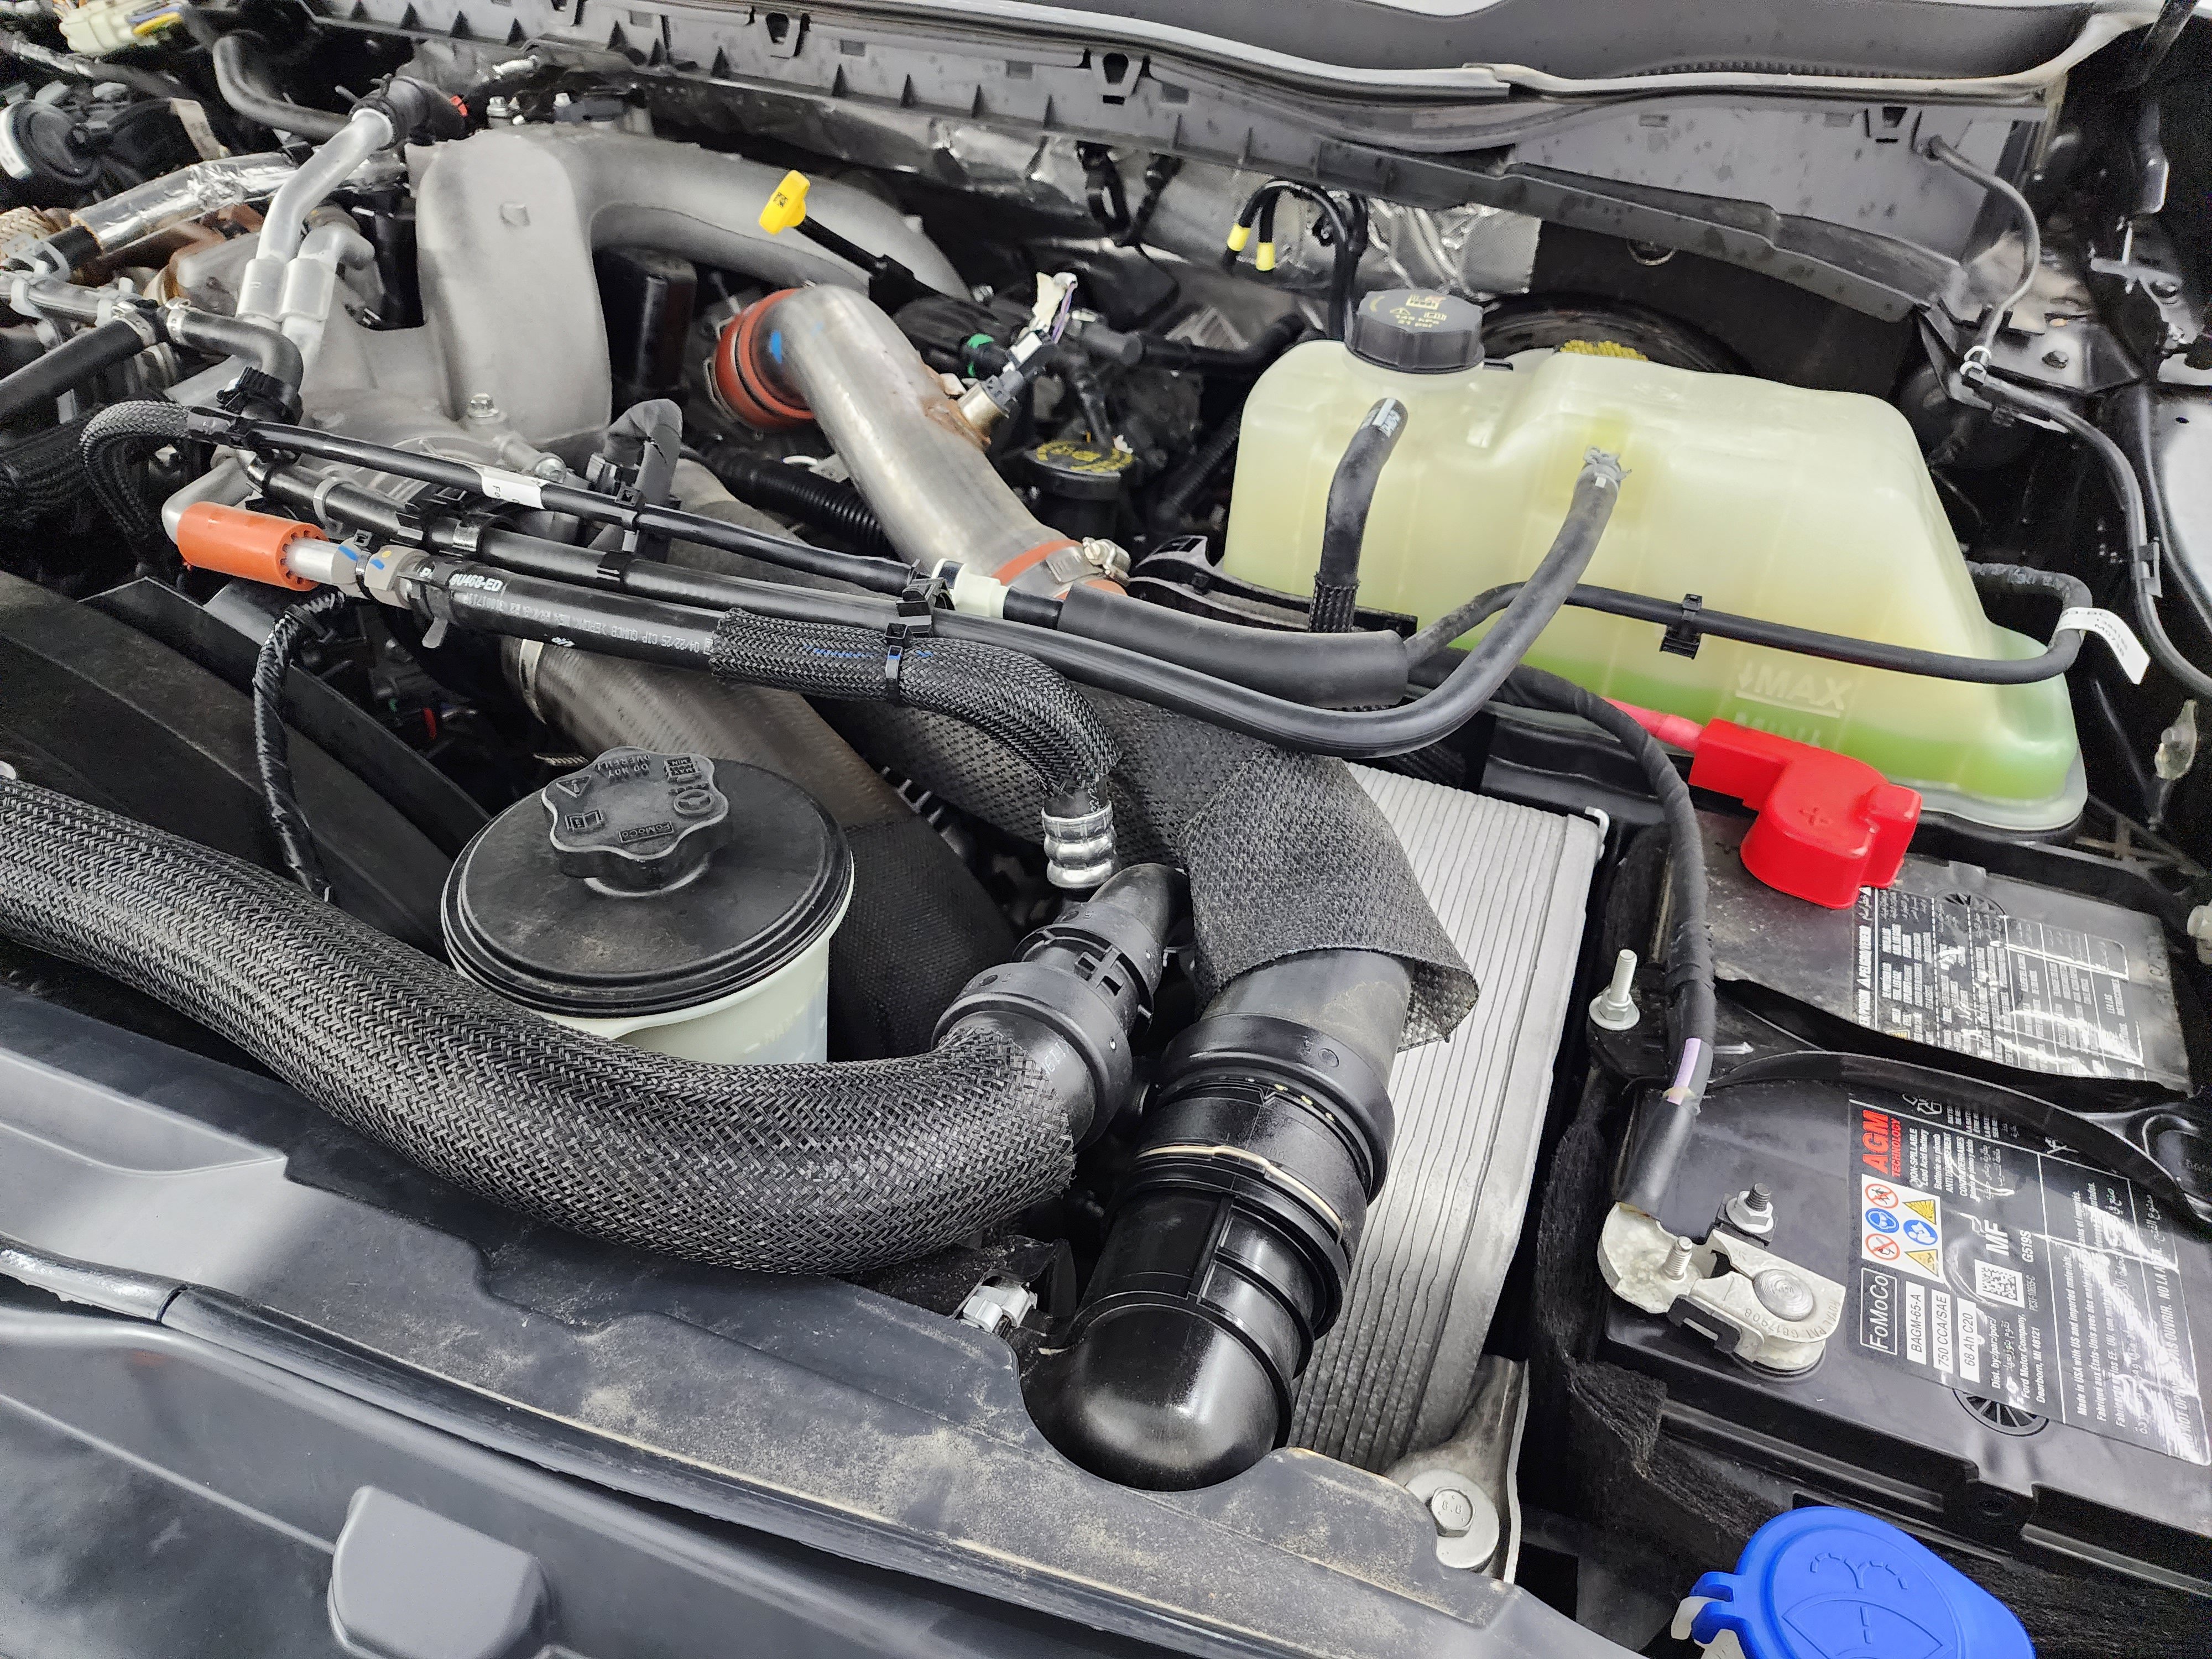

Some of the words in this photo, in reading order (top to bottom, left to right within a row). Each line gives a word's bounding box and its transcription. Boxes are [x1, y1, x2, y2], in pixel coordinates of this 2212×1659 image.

[622, 823, 670, 837] FoMoCo
[1863, 1111, 1888, 1172] AGM
[1891, 1119, 1901, 1176] TECHNOLOGY
[1919, 1129, 1929, 1152] Battery
[1933, 1133, 1942, 1154] plomb
[1909, 1129, 1918, 1183] NON-SPILLABLE
[1919, 1152, 1928, 1168] Acid
[1935, 1154, 1941, 1163] au
[1957, 1136, 1965, 1170] DERRAMES
[1919, 1168, 1928, 1186] Lead
[1933, 1164, 1942, 1190] Batterie
[1945, 1177, 1953, 1193] ANTI
[1984, 1220, 2008, 1255] MF
[2020, 1230, 2033, 1262] G519S
[2156, 1285, 2169, 1299] NO
[1870, 1275, 1889, 1349] FoMoCo
[2065, 1288, 2078, 1321] imported
[2085, 1300, 2094, 1313] des
[1910, 1295, 1922, 1352] BAGM-65-A
[1936, 1296, 1948, 1344] CCA/SAE
[1962, 1312, 1973, 1333] C20
[2069, 1321, 2079, 1336] and
[2088, 1313, 2096, 1332] avec
[2106, 1317, 2114, 1331] con
[2018, 1314, 2027, 1352] Company,
[2031, 1326, 2041, 1349] 48121
[2070, 1336, 2080, 1348] US
[1963, 1336, 1974, 1352] Ah
[2088, 1332, 2100, 1371] États-Unis
[1938, 1347, 1949, 1366] 750
[1964, 1353, 1975, 1366] 68
[2020, 1353, 2028, 1377] Motor
[2032, 1350, 2042, 1361] MI
[2071, 1349, 2081, 1365] with
[2073, 1366, 2084, 1383] USA
[2109, 1361, 2119, 1374] los
[1991, 1370, 2000, 1389] Dist.
[2020, 1378, 2030, 1398] Ford
[2035, 1363, 2045, 1402] Dearborn,
[2075, 1384, 2084, 1392] in
[2093, 1371, 2102, 1386] aux
[2077, 1393, 2086, 1415] Made
[2094, 1386, 2106, 1421] Fabriqué
